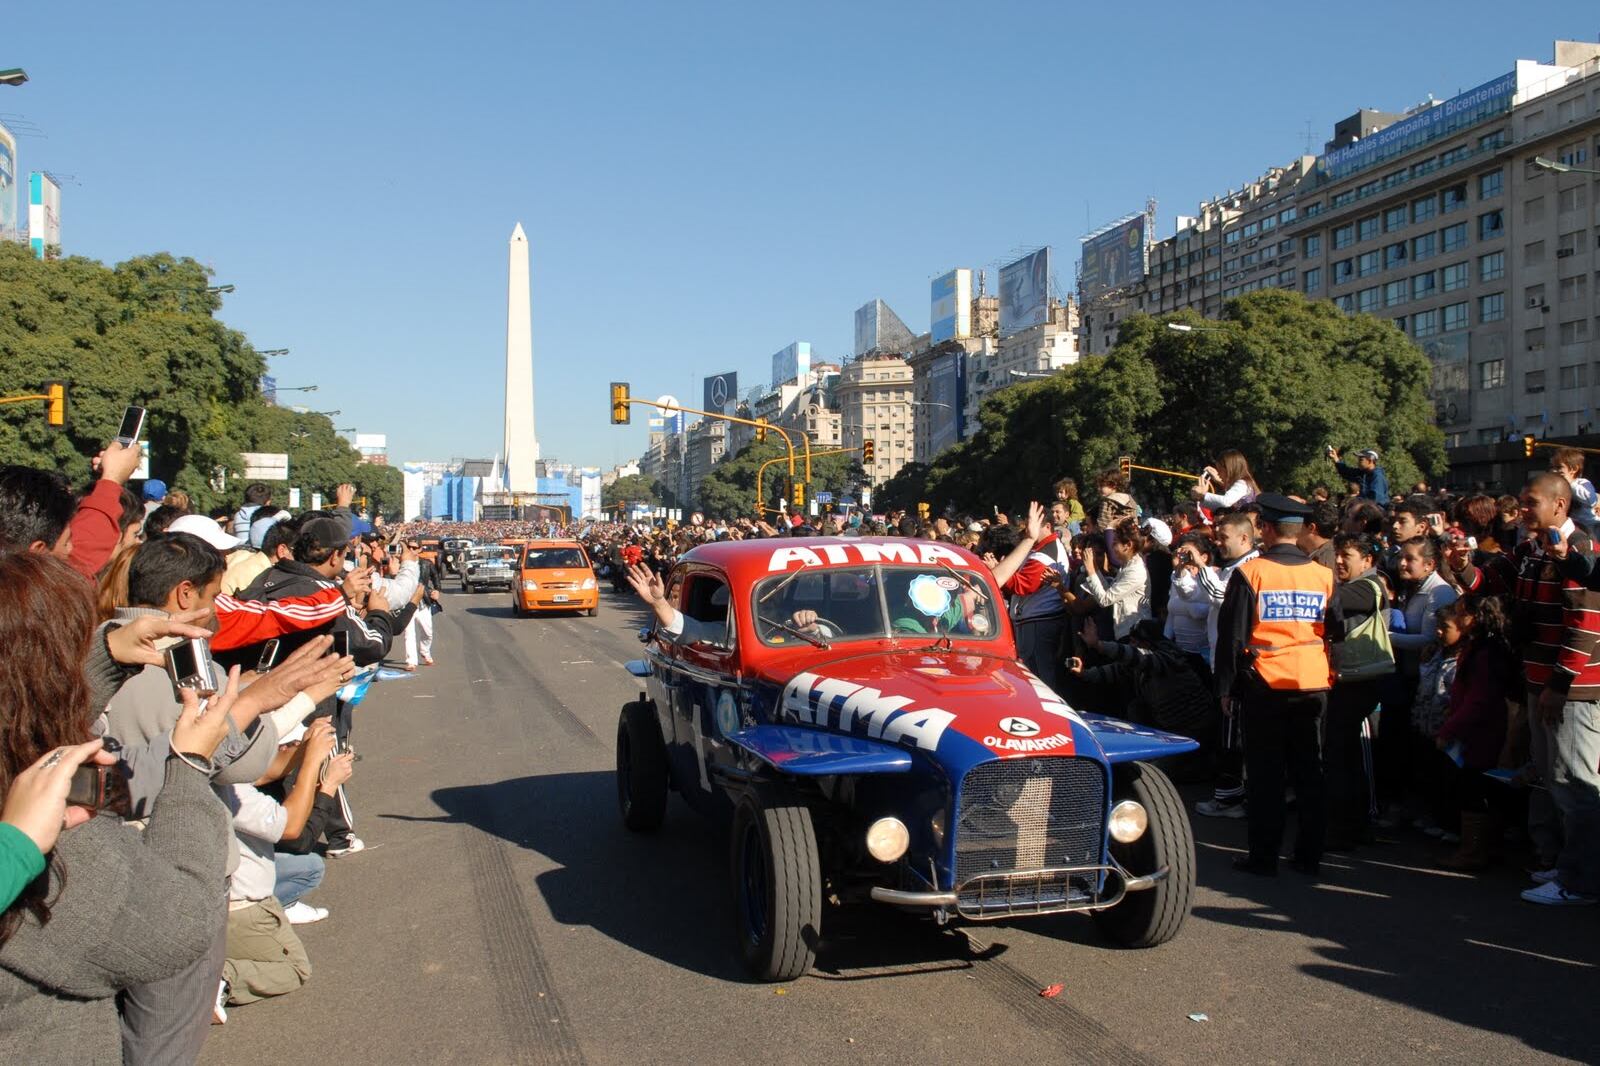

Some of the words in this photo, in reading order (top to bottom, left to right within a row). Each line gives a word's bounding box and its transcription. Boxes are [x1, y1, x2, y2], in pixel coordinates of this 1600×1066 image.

[1325, 152, 1340, 168] NH
[1342, 138, 1377, 160] Hoteles
[1379, 115, 1430, 145] acompaña
[1433, 107, 1443, 122] el
[767, 543, 969, 572] ATMA
[1266, 595, 1320, 607] POLICIA
[1267, 607, 1318, 618] FEDERAL
[781, 671, 957, 752] ATMA
[983, 733, 1073, 752] OLAVARRIA
[1007, 777, 1054, 879] 1
